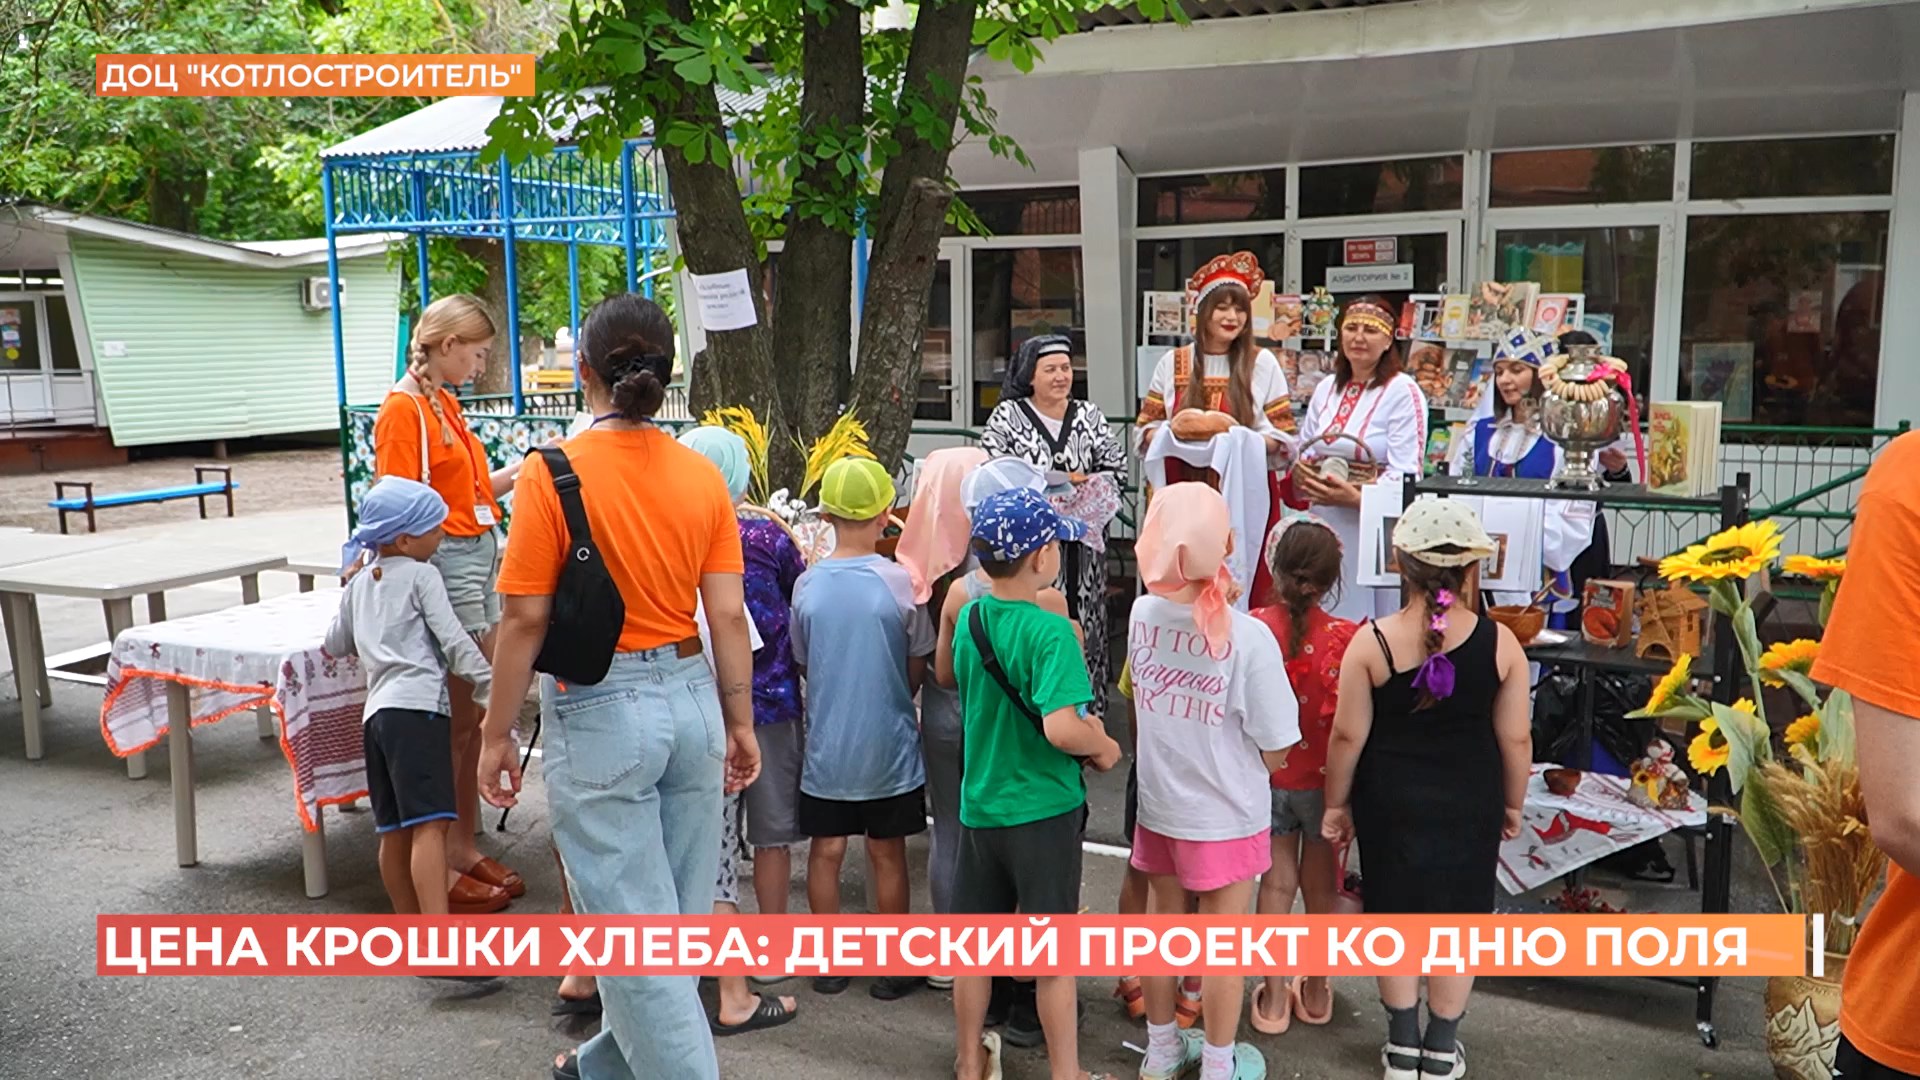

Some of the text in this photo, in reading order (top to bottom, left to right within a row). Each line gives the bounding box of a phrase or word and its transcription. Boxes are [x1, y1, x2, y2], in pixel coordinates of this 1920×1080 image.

[1331, 272, 1389, 284] АУДИТОРИЯ
[1166, 628, 1233, 663] TOO
[1130, 645, 1229, 697] Gorgeous
[1163, 692, 1226, 728] THIS
